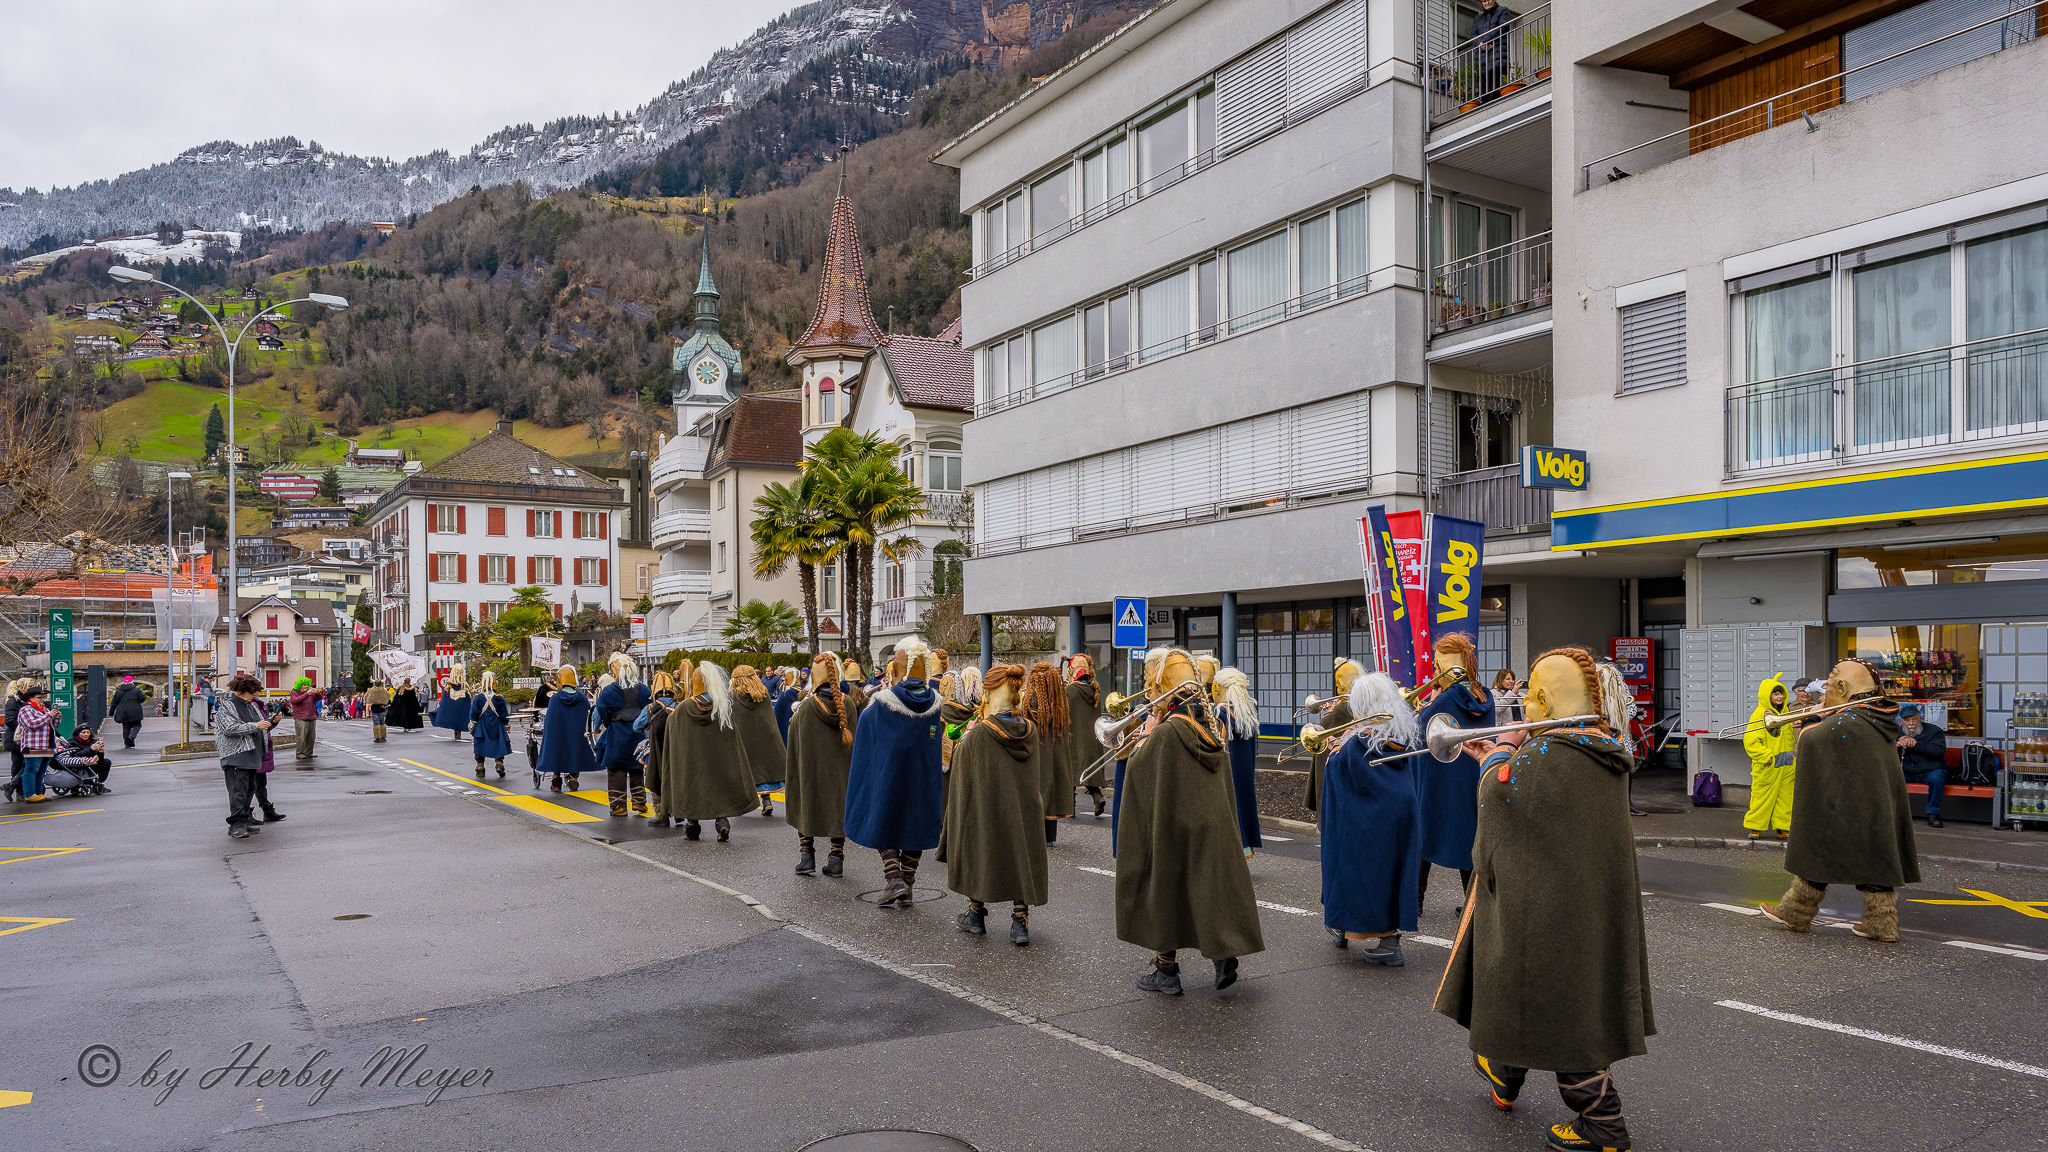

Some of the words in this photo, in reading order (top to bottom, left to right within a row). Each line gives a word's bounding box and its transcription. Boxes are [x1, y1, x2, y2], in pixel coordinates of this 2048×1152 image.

[1536, 451, 1584, 486] Volg
[1437, 540, 1478, 624] Volg
[1623, 663, 1644, 673] 120
